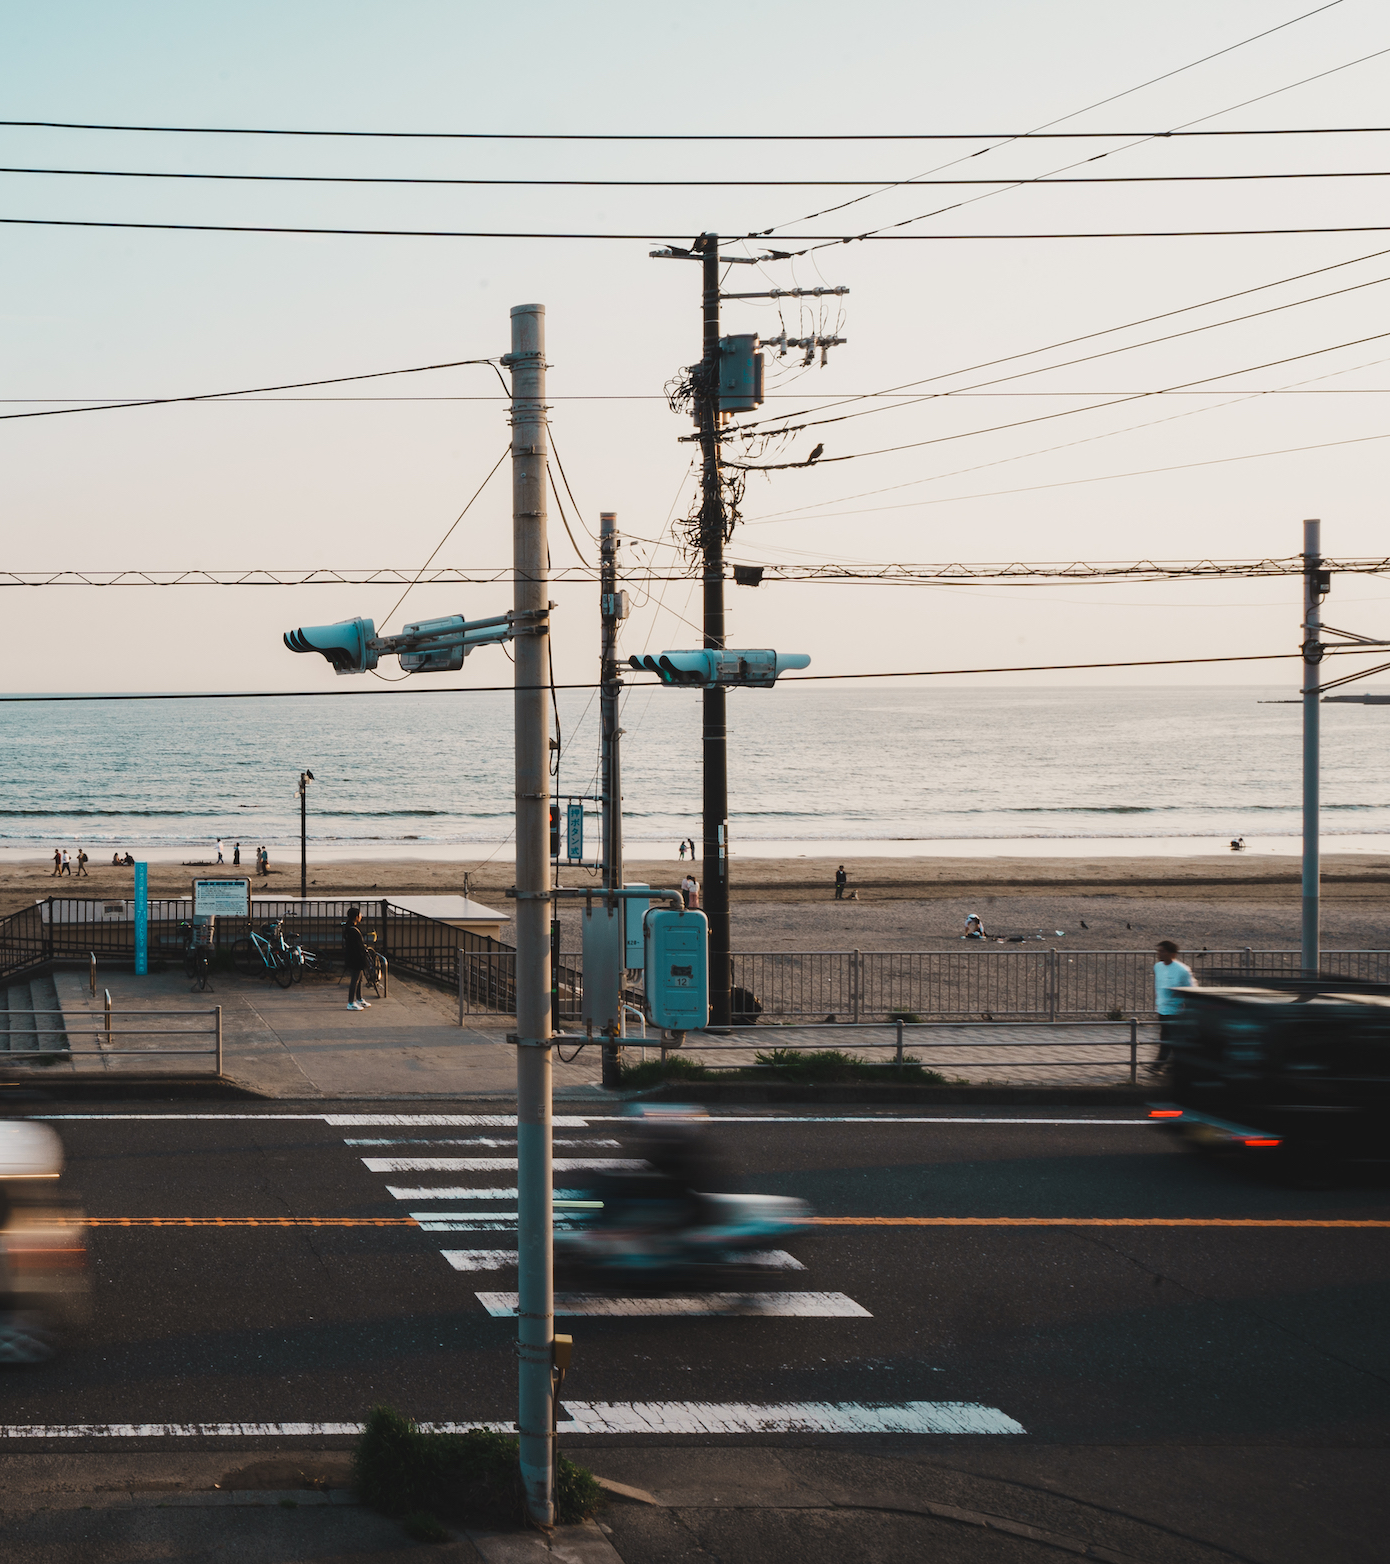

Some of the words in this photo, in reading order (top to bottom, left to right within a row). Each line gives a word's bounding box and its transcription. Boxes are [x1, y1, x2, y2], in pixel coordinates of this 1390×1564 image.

[570, 809, 580, 855] 押ボタン式
[677, 978, 687, 986] 12
